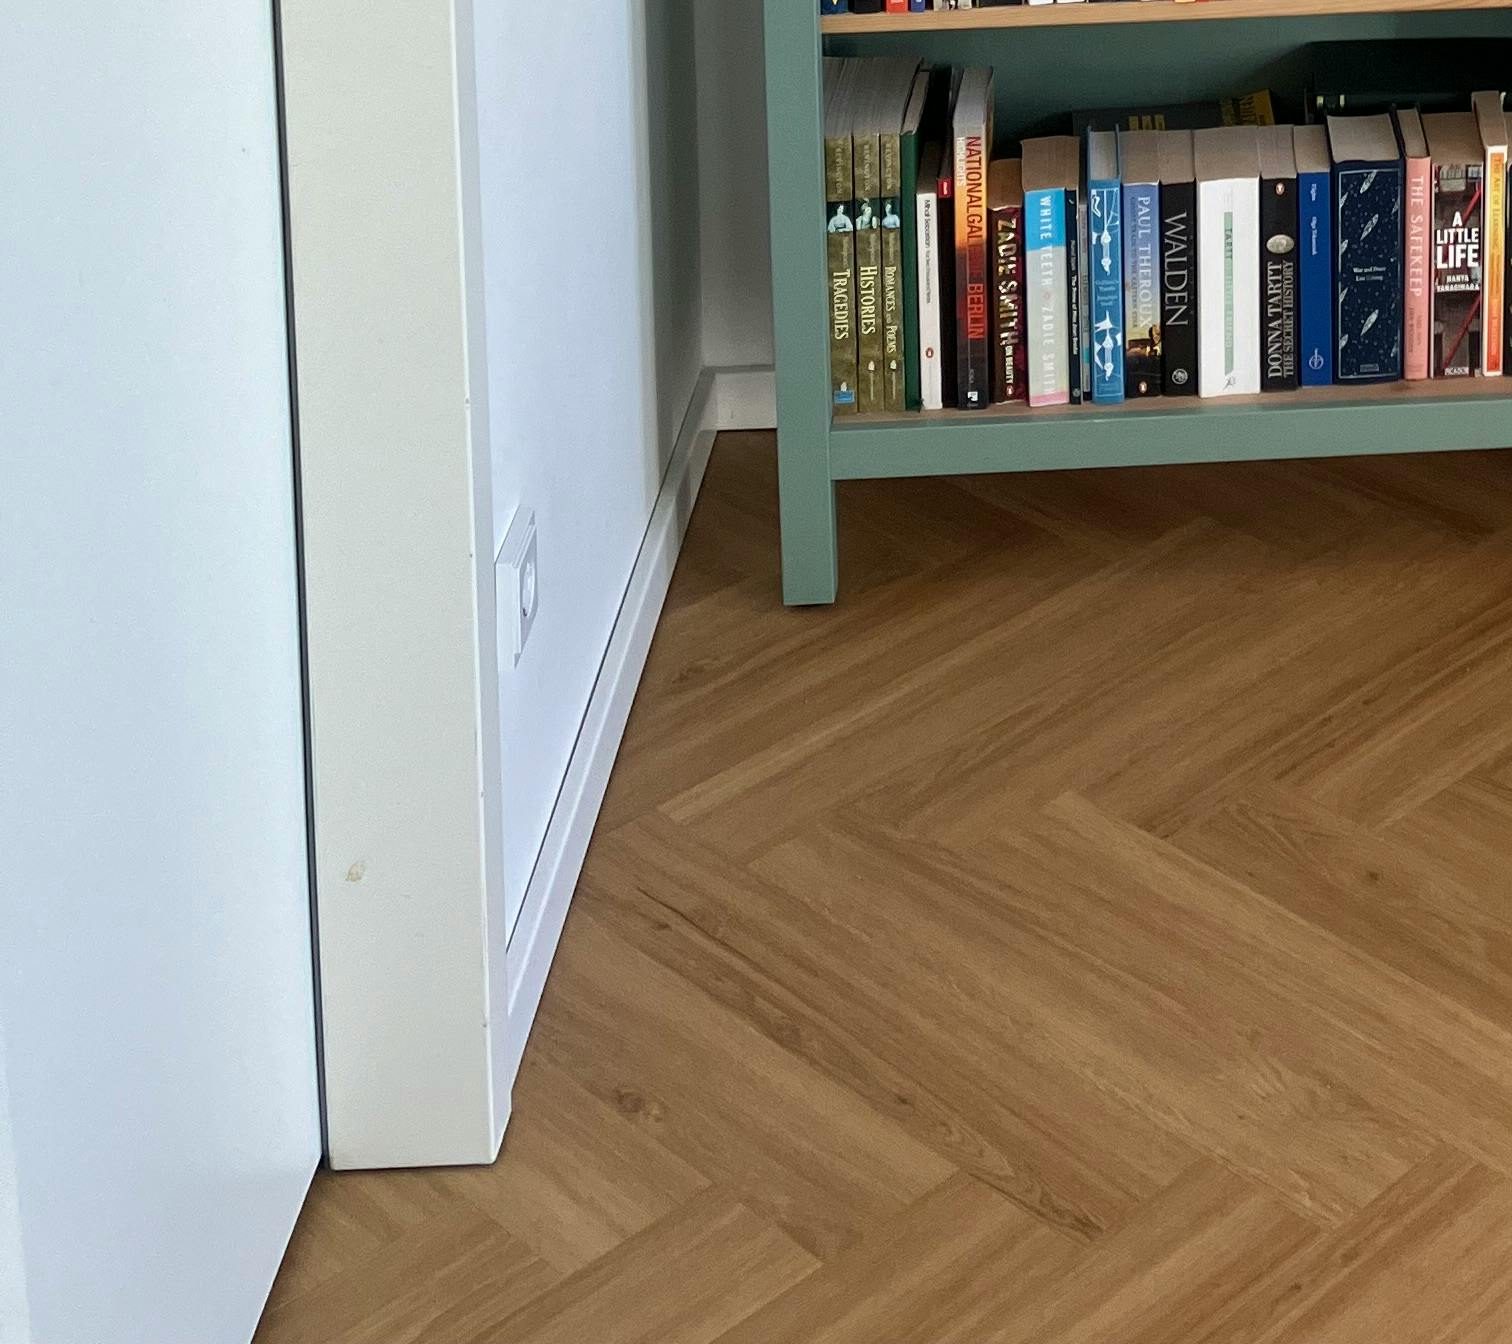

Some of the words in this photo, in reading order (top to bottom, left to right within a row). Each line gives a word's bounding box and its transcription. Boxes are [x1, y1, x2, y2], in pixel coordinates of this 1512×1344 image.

[1137, 196, 1151, 238] PAUL
[1411, 175, 1424, 206] THE
[1451, 211, 1463, 226] A
[998, 217, 1019, 275] ZADIE
[1409, 215, 1423, 297] SAFEKEEP
[1436, 228, 1479, 245] LITTLE
[1436, 245, 1480, 269] LIFE
[1138, 243, 1152, 329] THEROUX
[1163, 212, 1189, 327] WALDEN
[1268, 261, 1282, 318] TARTT
[832, 268, 852, 340] TRAGEDIES
[860, 266, 878, 335] HISTORIES
[998, 280, 1020, 346] SMITH
[1268, 322, 1281, 379] DONNA
